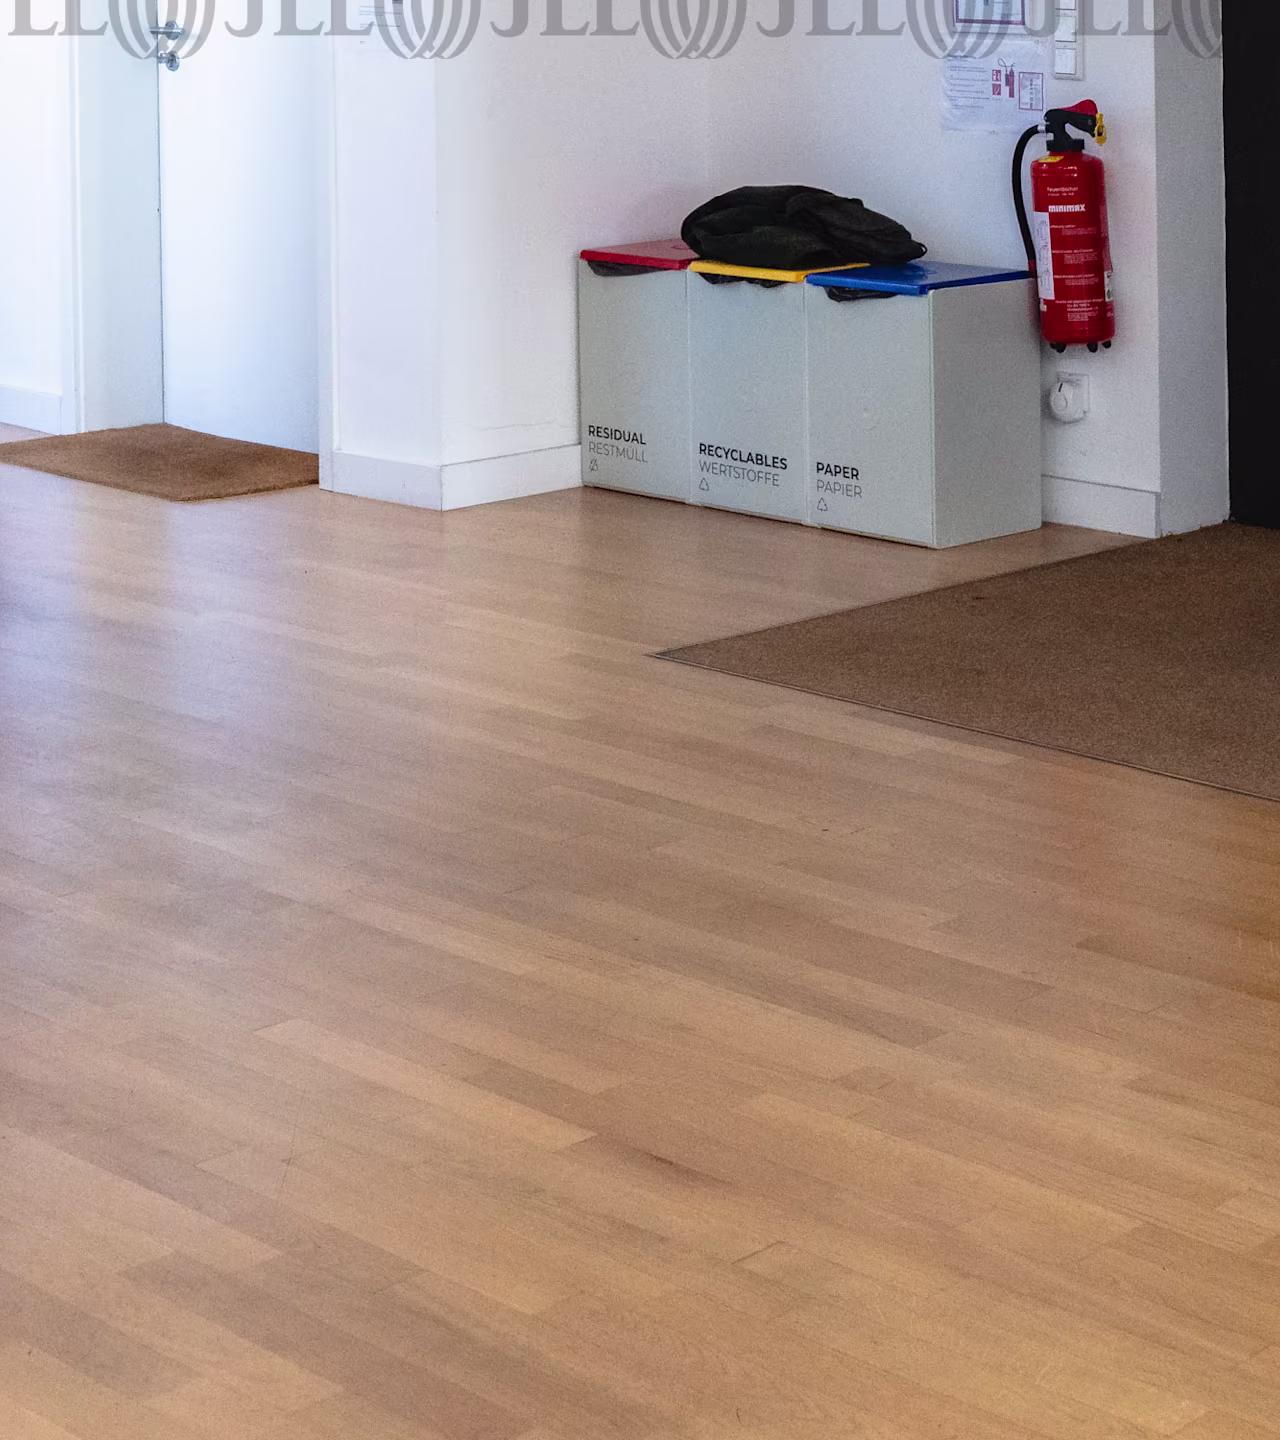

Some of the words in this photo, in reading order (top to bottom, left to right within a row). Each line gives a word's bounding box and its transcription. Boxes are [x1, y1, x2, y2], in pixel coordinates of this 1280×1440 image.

[1048, 203, 1086, 213] minimax
[588, 424, 647, 445] RESIDUAL
[588, 442, 649, 463] RESTMÜLL
[699, 443, 788, 470] RECYCLABLES
[699, 460, 780, 487] WERTSTOFFE
[816, 462, 860, 481] PAPER
[816, 479, 863, 499] PAPIER
